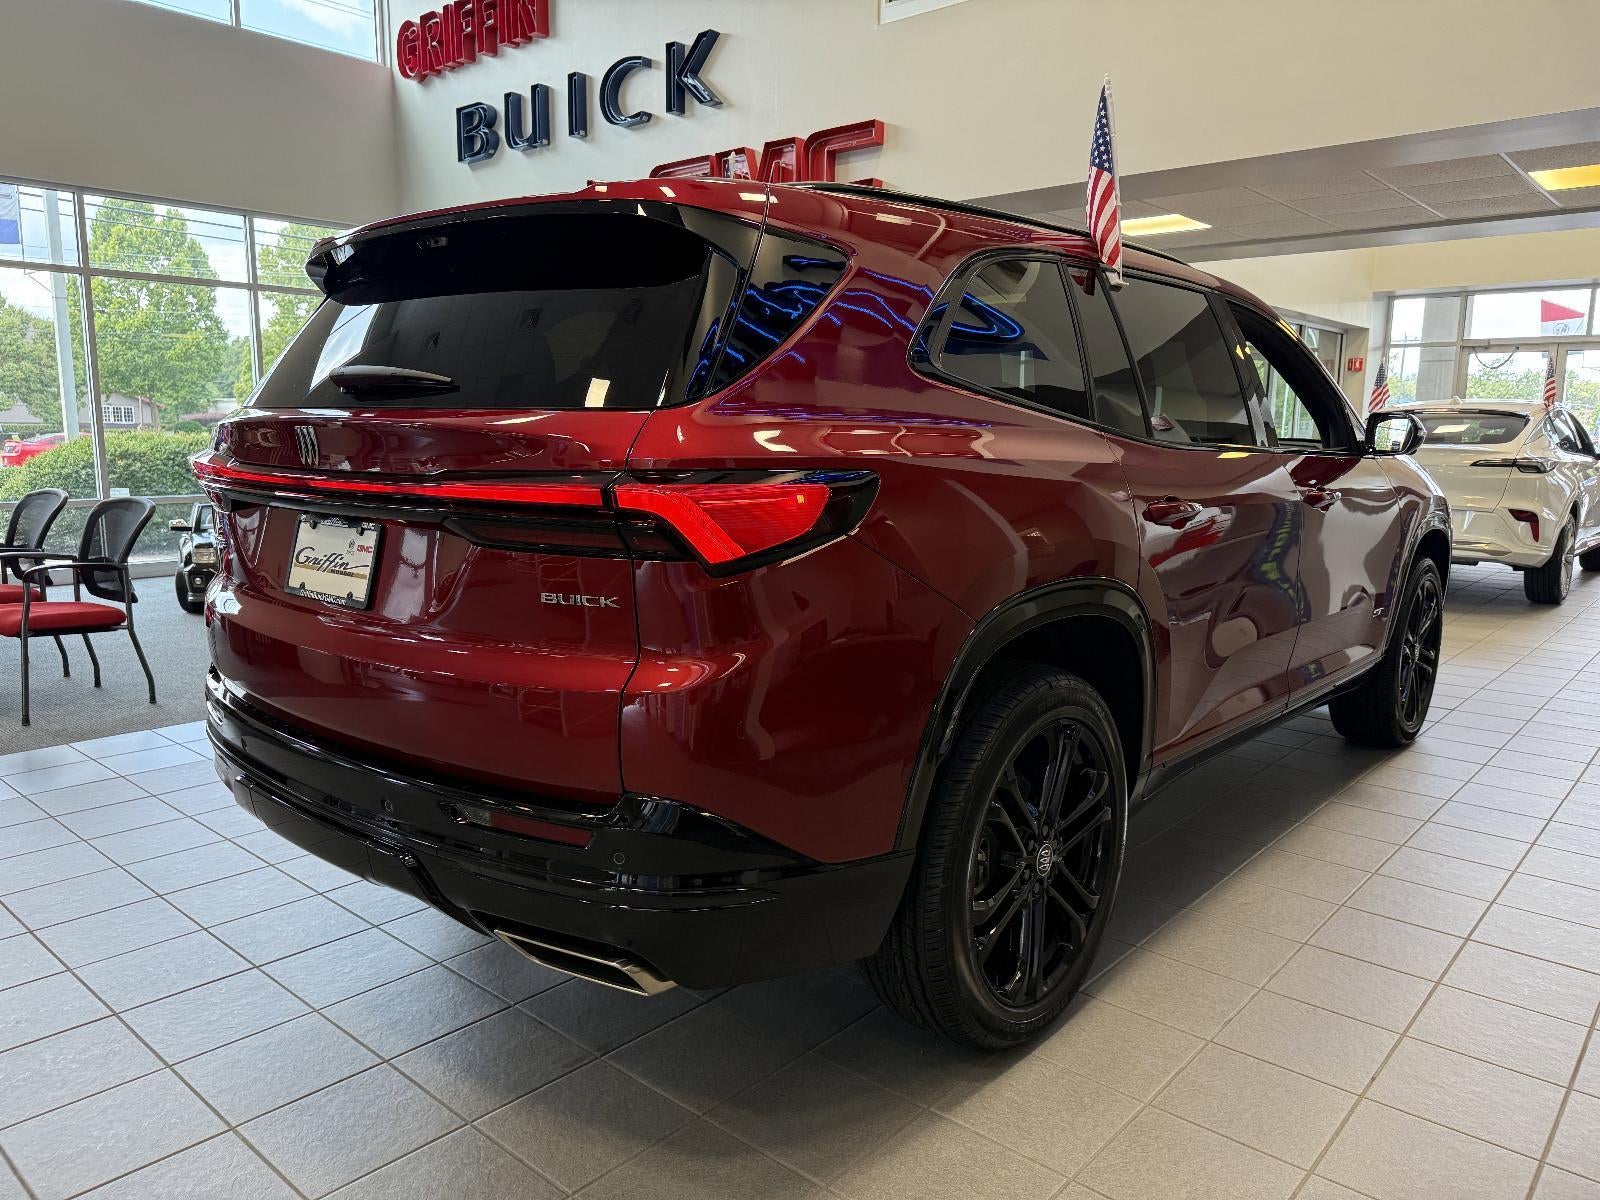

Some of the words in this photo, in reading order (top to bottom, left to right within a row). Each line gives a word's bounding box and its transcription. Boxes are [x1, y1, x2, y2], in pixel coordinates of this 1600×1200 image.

[397, 0, 549, 82] GRIFFIN
[456, 29, 723, 164] BUICK
[295, 547, 369, 572] Griffin
[540, 592, 620, 608] BUICK
